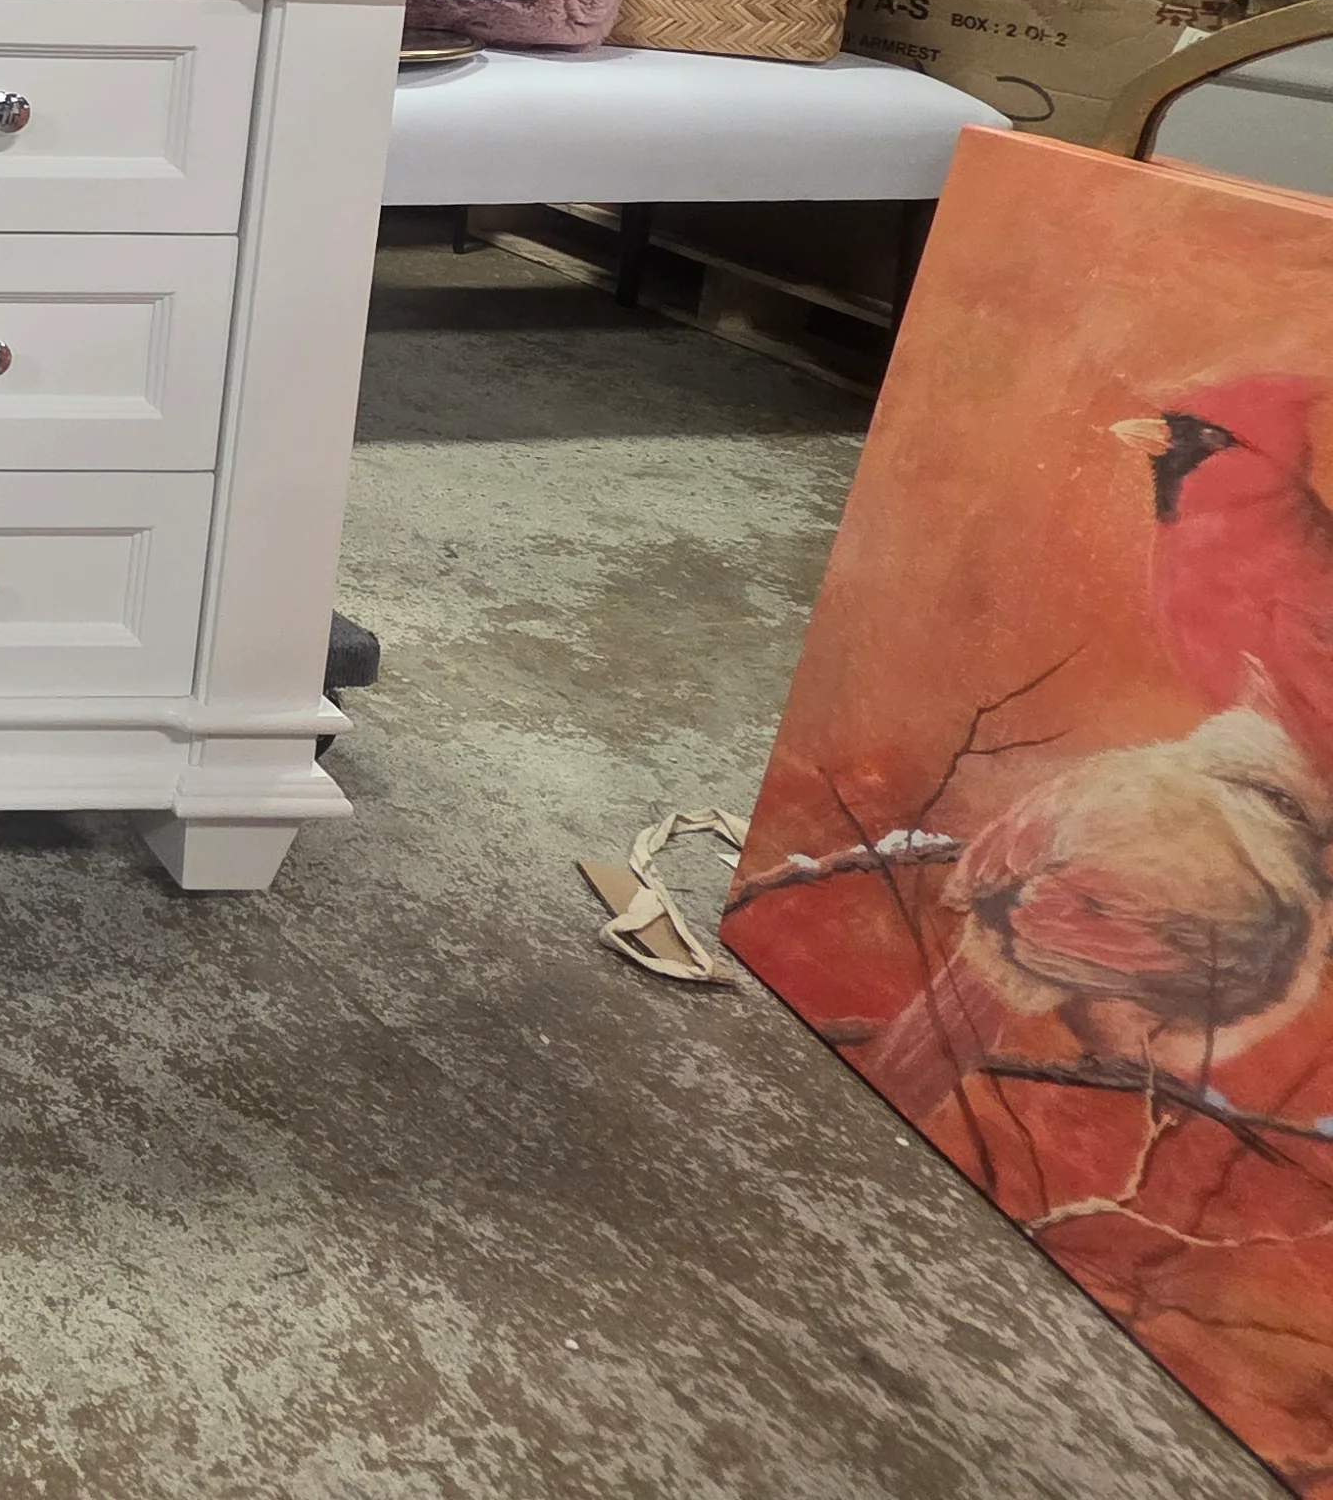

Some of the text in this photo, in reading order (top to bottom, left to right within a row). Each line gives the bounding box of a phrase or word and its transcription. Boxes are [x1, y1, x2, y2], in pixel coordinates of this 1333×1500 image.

[951, 13, 989, 32] BOX
[1006, 23, 1017, 38] 2
[1054, 32, 1067, 47] 2
[859, 34, 941, 62] ARMREST
